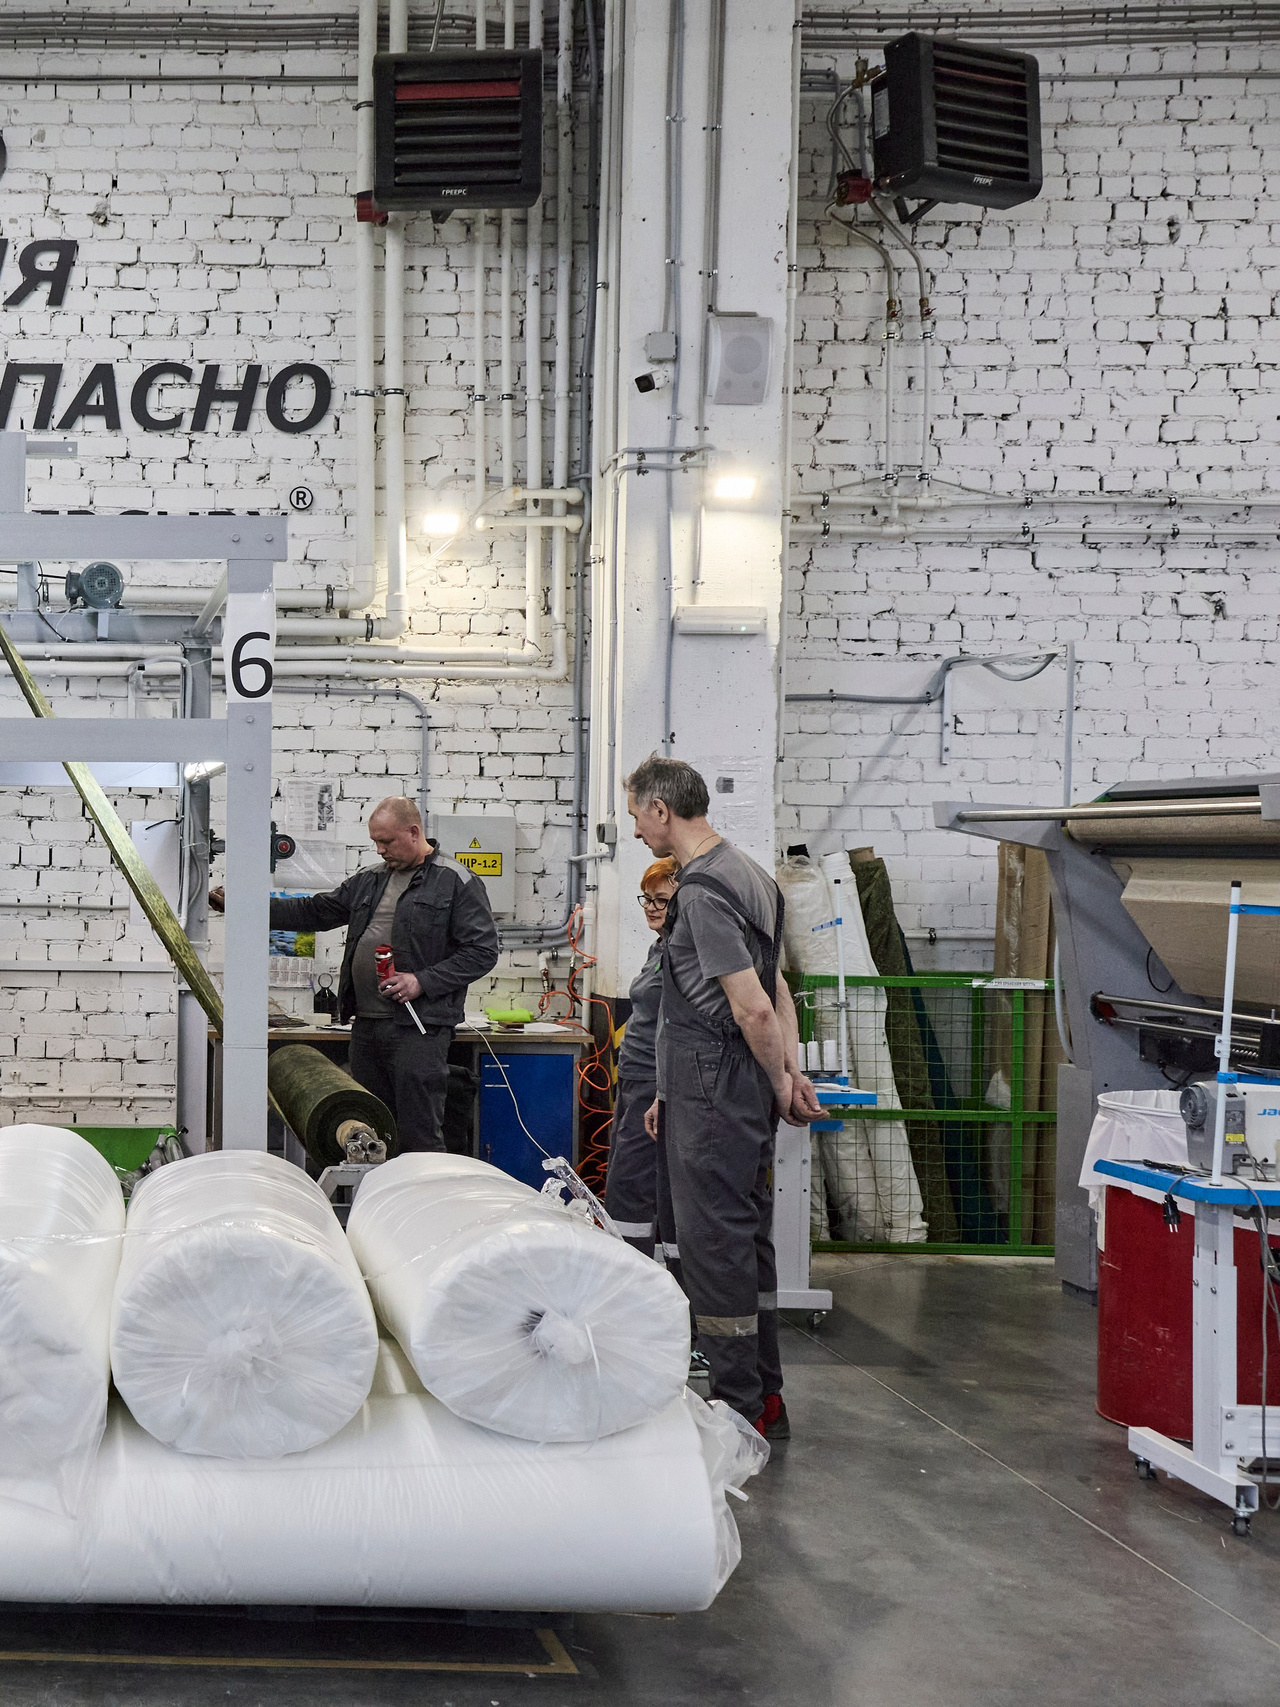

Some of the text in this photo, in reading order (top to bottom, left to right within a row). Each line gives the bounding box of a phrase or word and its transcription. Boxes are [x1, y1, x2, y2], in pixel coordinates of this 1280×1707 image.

[441, 188, 467, 196] ГРЕЕРС
[231, 631, 273, 699] 6
[1257, 1108, 1280, 1116] Ja
